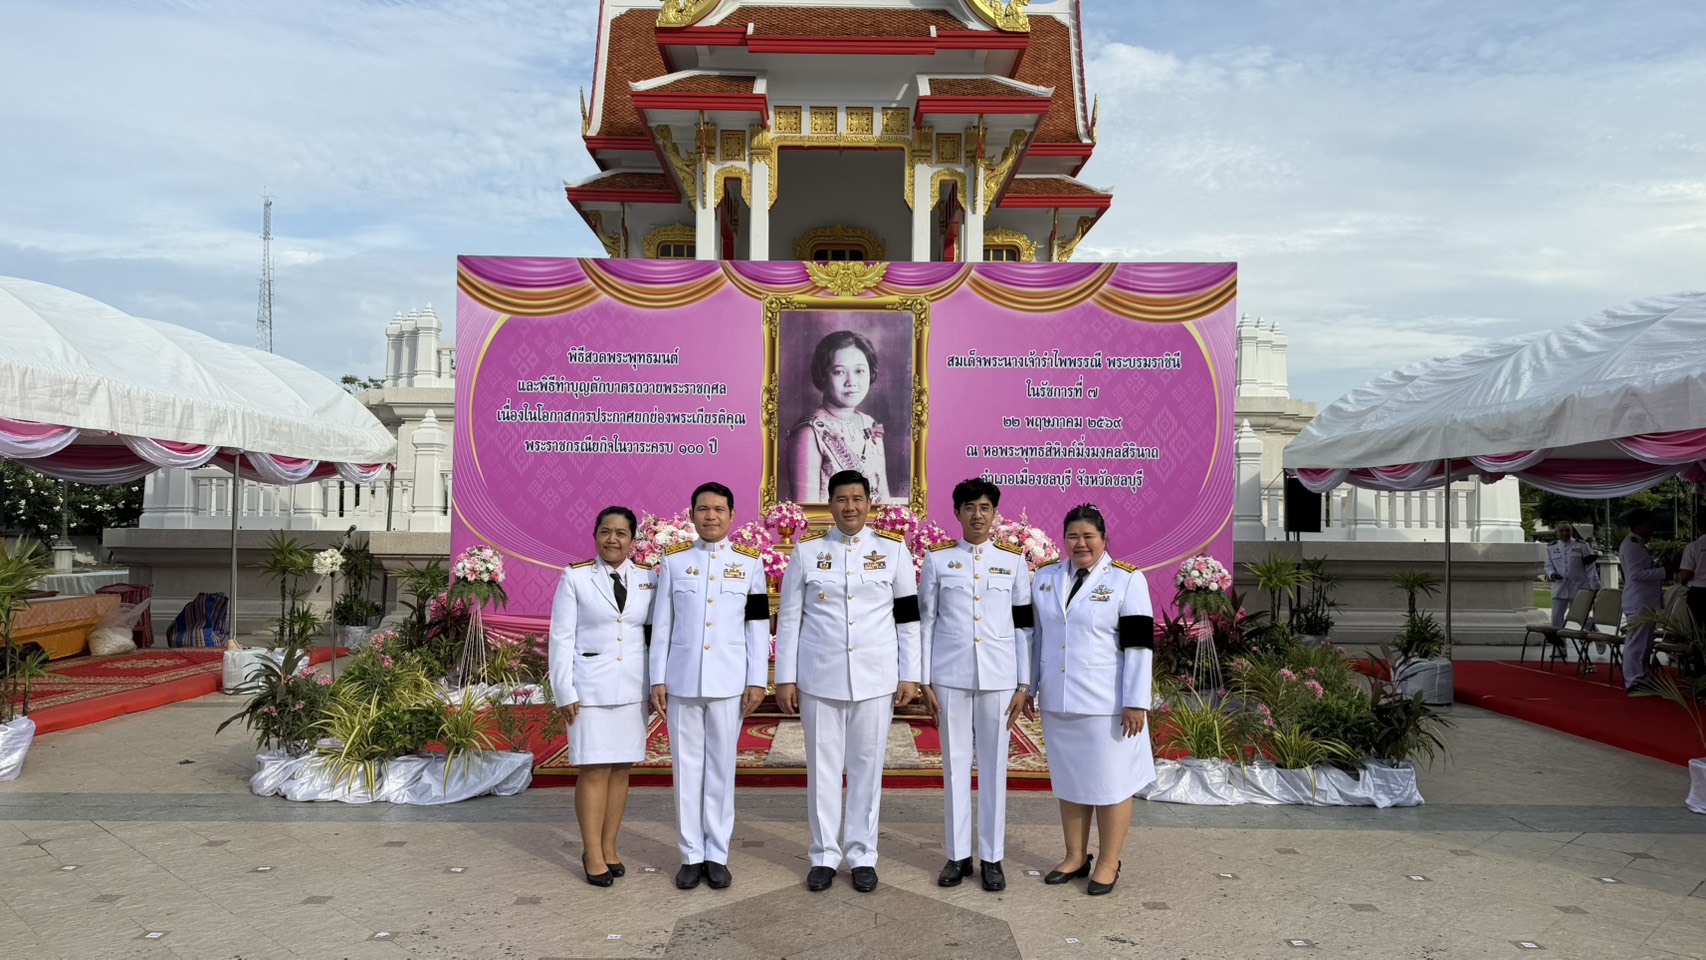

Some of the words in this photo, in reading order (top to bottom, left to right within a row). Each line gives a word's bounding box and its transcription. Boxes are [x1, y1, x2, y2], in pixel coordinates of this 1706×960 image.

[568, 346, 680, 369] พิธีสวดพระพุทธมนต์
[947, 350, 1102, 369] สมเด็จพระนางเจ้ารำไพพรรณี
[1107, 352, 1181, 369] พระบรมราชินี
[518, 375, 726, 400] และพิธีทำบุญตักบาตรถวายพระราชกุศล
[1087, 387, 1099, 398] ๗
[497, 399, 746, 430] เนื่องในโอกาสการประกาศยกย่องพระเกียรติคุณ
[1003, 416, 1021, 428] ๒๒
[1025, 416, 1083, 431] พฤษภาคม
[1087, 417, 1122, 428] ๒๕๖๙
[525, 435, 674, 454] พระราชกรณียกิจในวาระครบ
[679, 444, 704, 455] ๑๐๐
[708, 437, 718, 454] ปี
[966, 445, 978, 457] ณ
[983, 436, 1159, 463] หอพระพุทธสิหิงค์มิ่งมงคลสิรินาถ
[1076, 469, 1144, 492] จังหวัดชลบุรี
